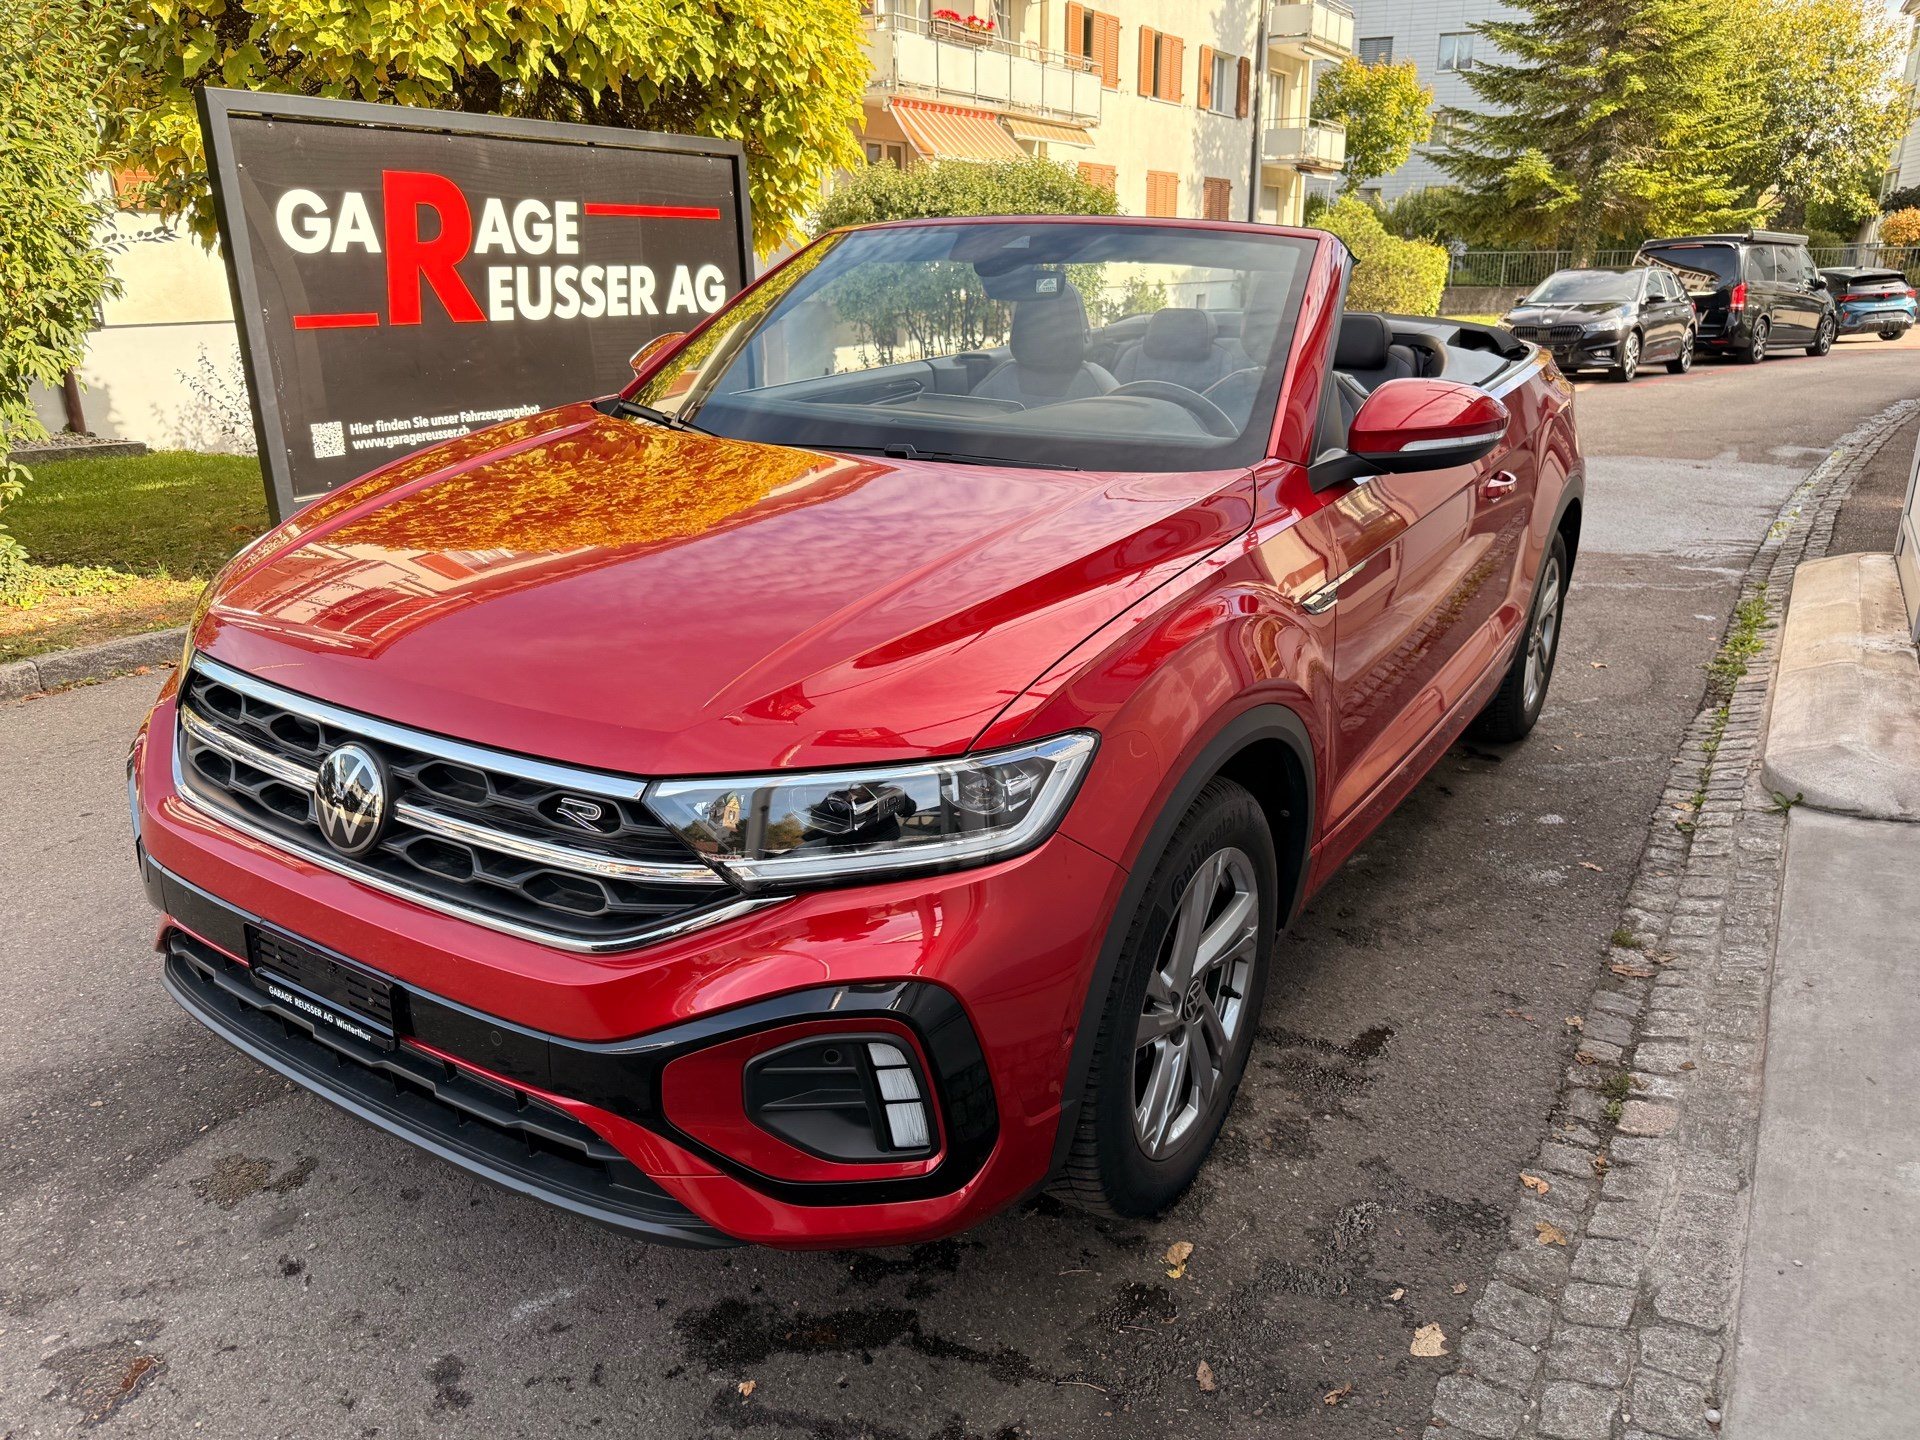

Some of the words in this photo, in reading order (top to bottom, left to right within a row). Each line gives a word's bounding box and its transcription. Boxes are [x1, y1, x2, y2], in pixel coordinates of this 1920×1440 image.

[666, 264, 726, 314] AG
[350, 420, 374, 436] Hier
[376, 418, 411, 434] finden
[413, 415, 430, 429] Sie
[431, 414, 459, 426] unser
[460, 404, 541, 422] Fahrzeugangebot
[352, 426, 471, 449] www.garagereusser.ch
[268, 985, 293, 1004] GARAGE
[295, 999, 322, 1018] REUSSER
[323, 1012, 334, 1023] AG
[336, 1018, 372, 1042] Winterthur
